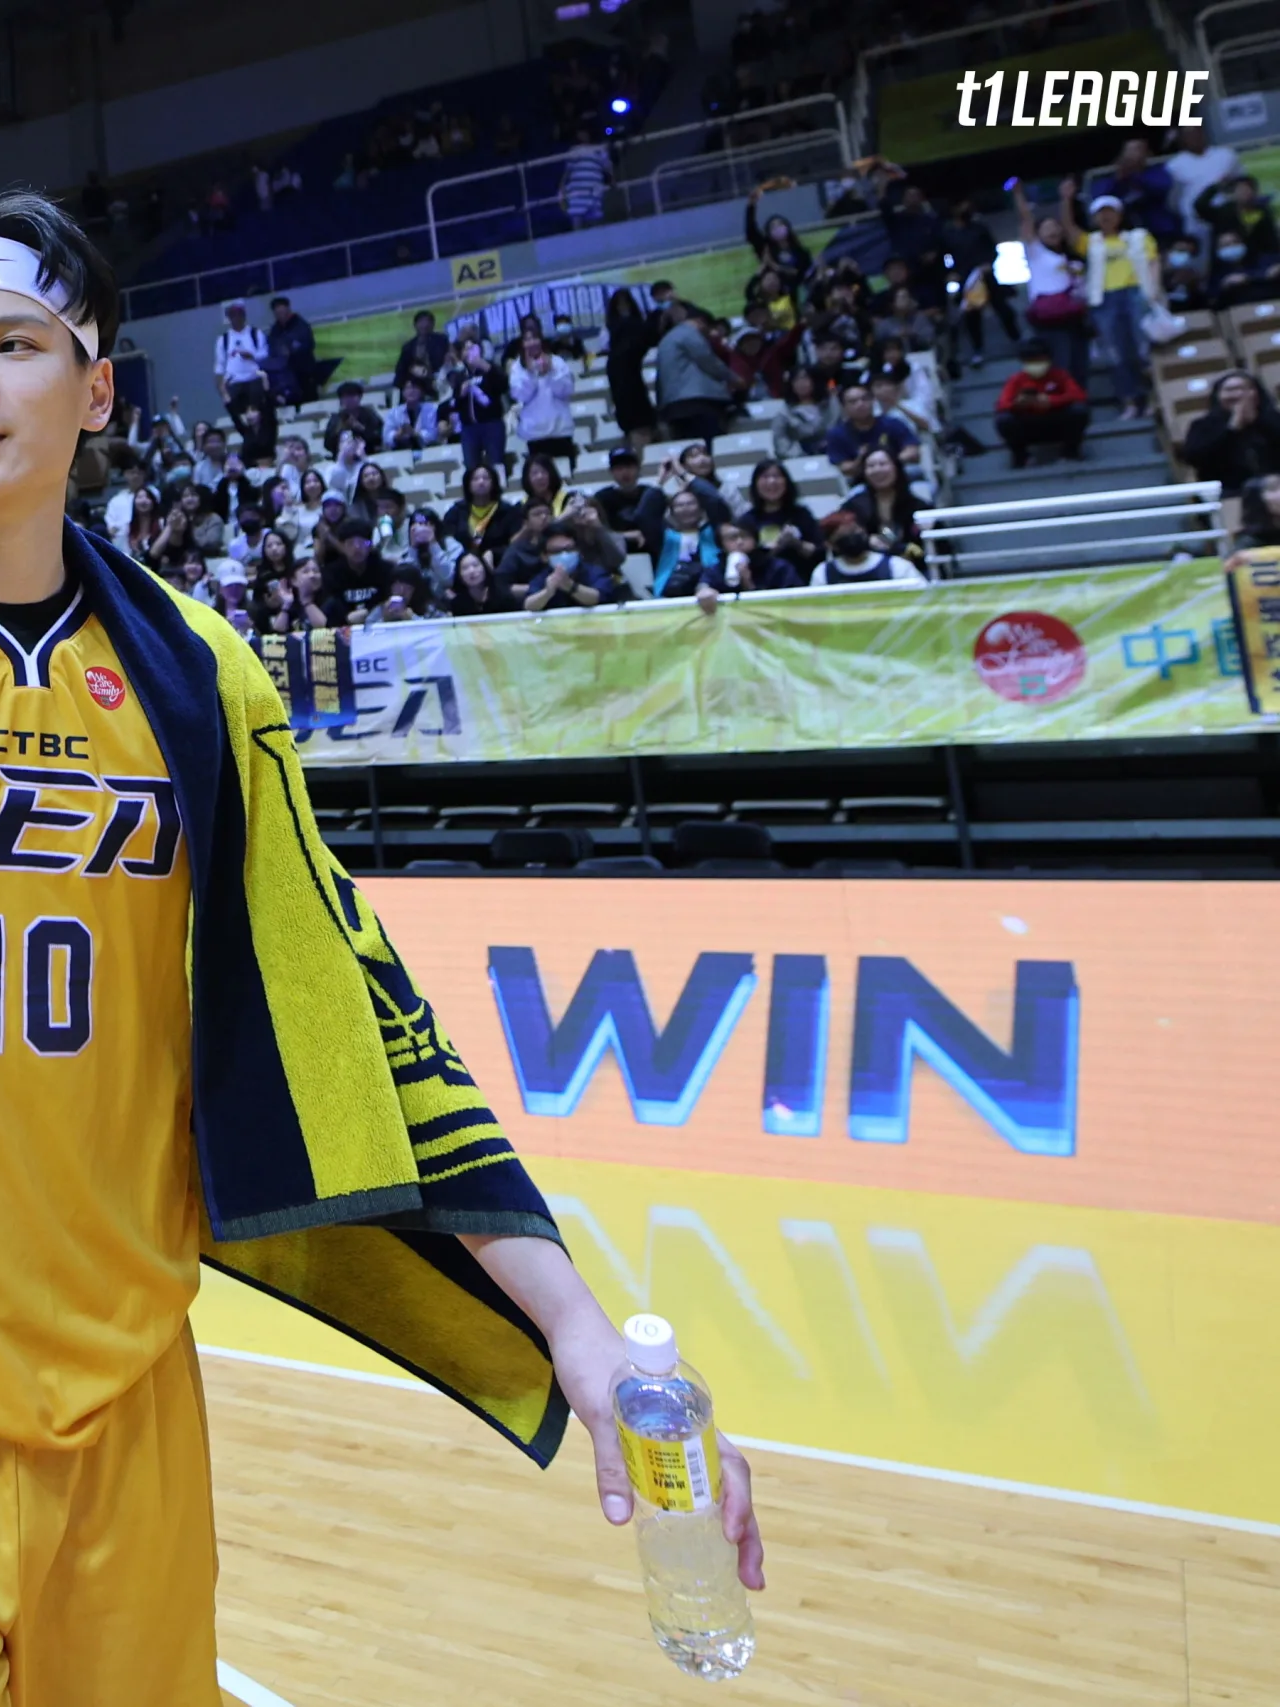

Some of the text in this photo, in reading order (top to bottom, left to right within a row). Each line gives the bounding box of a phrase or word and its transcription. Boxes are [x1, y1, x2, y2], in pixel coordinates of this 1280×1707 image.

[457, 259, 497, 285] A2
[356, 656, 389, 674] BC
[487, 945, 1080, 1157] WIN
[634, 1320, 659, 1338] 10
